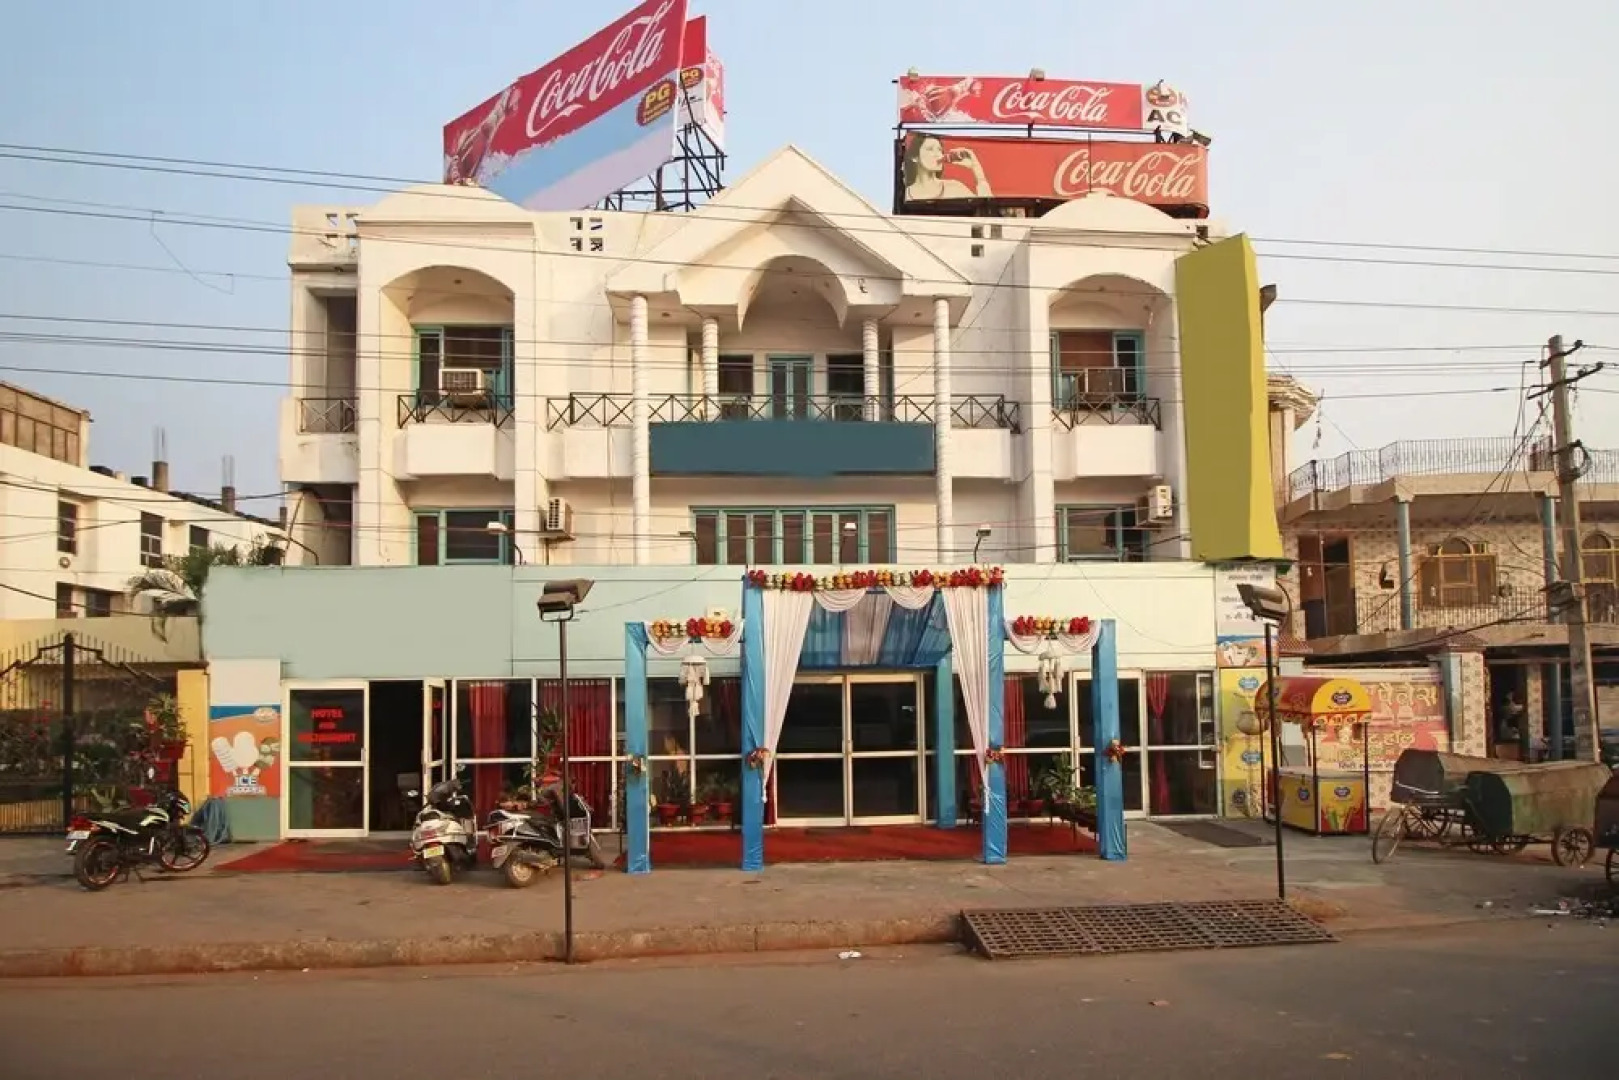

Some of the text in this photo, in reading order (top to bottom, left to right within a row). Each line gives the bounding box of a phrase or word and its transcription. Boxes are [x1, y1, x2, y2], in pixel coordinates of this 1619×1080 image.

[645, 82, 671, 109] PG
[992, 82, 1113, 121] Coca-Cola
[1053, 148, 1201, 198] Coca-Cola
